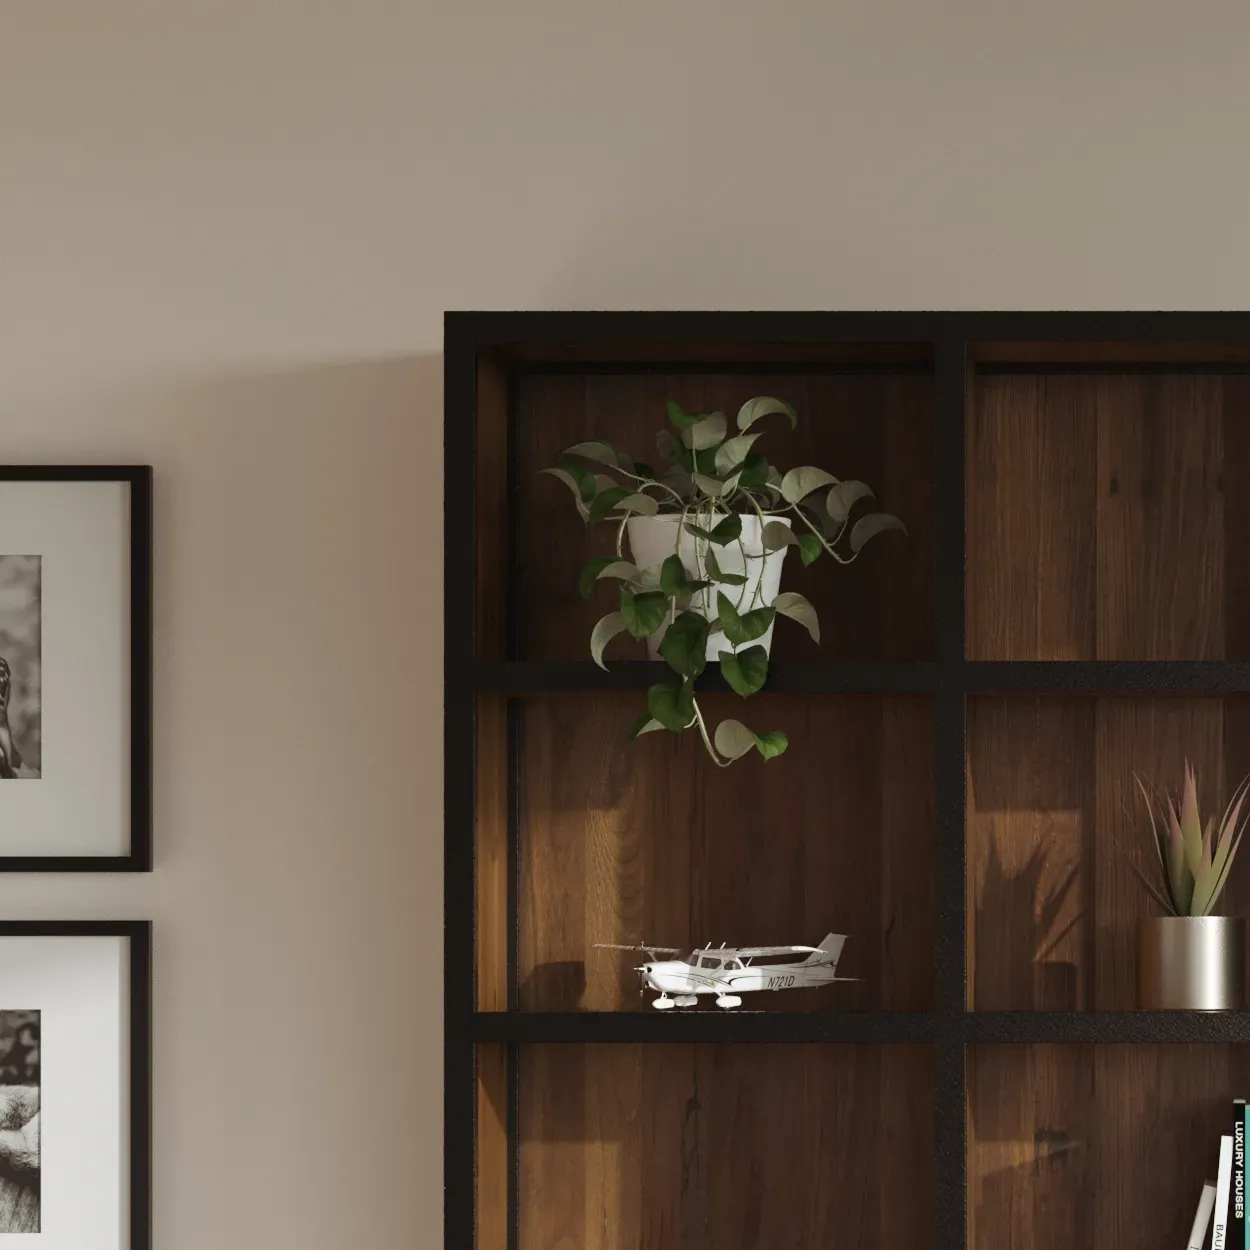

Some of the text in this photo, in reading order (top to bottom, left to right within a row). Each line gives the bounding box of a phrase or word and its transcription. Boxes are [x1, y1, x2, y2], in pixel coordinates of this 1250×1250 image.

[767, 975, 795, 988] N721D
[1234, 1121, 1244, 1219] LUXURY HOUSES
